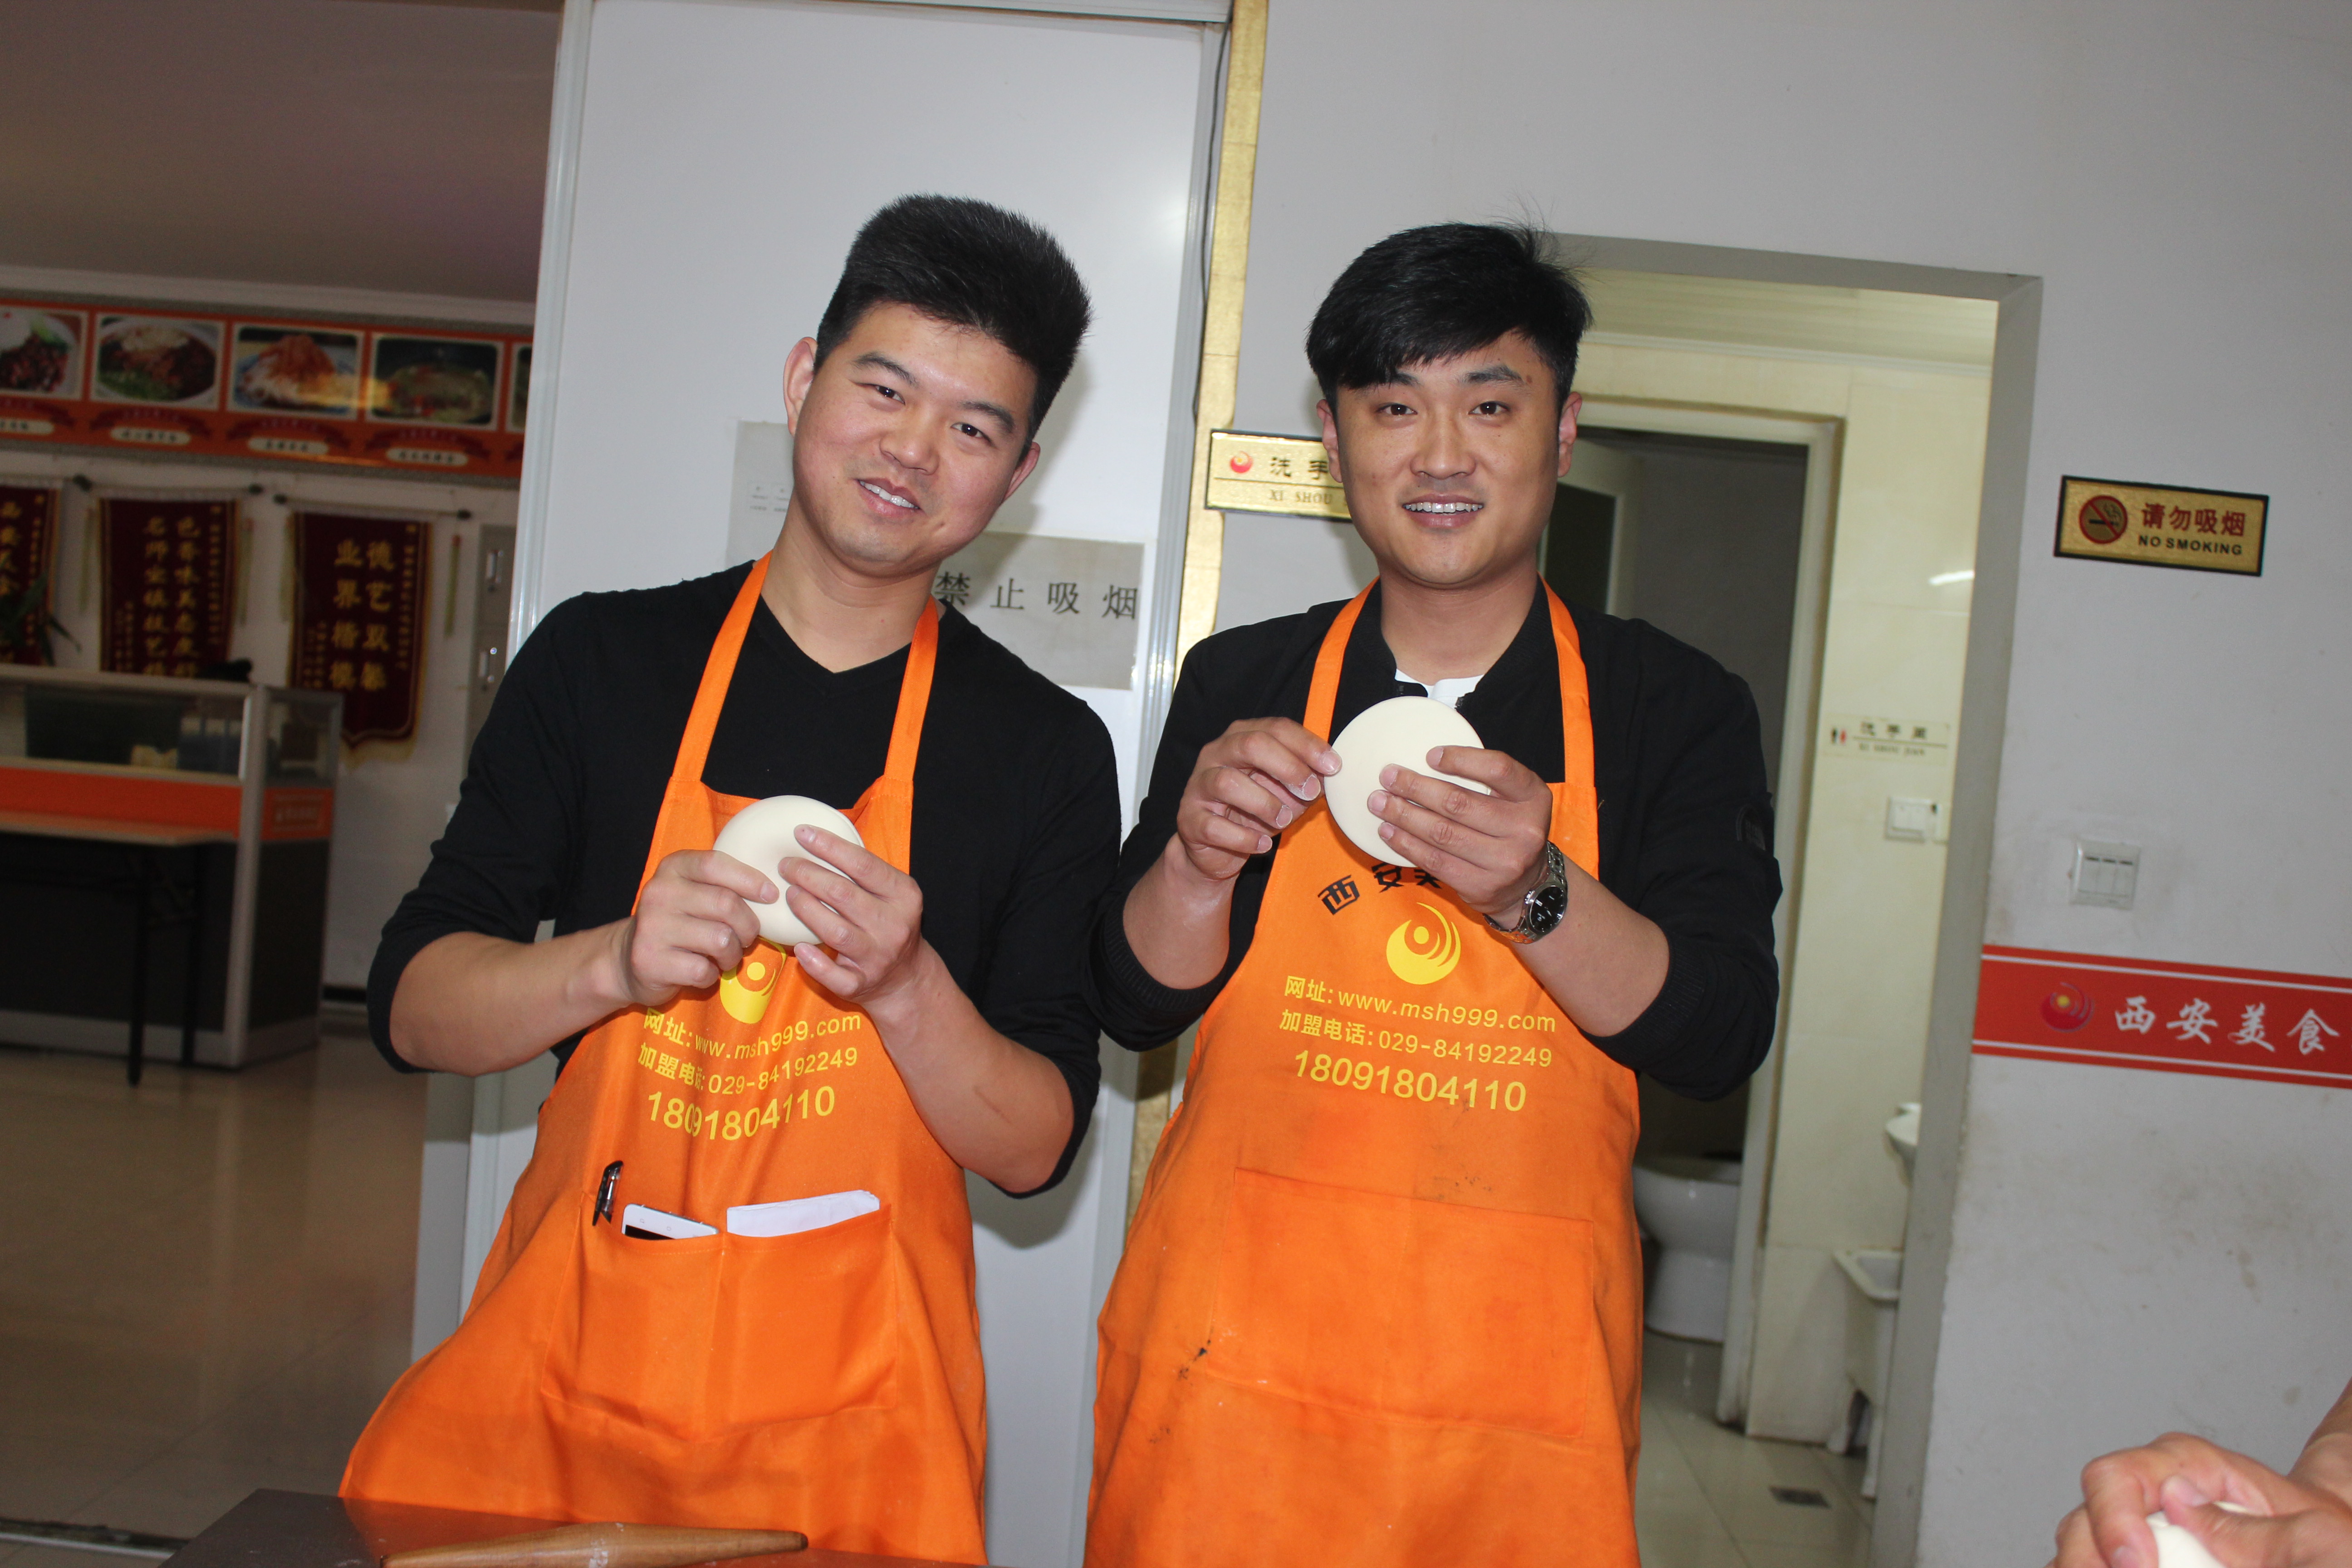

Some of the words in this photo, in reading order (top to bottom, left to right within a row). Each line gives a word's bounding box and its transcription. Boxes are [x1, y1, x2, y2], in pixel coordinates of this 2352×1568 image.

[1270, 489, 1284, 501] XI
[1295, 490, 1333, 505] SHOU
[2141, 502, 2246, 537] 请勿吸烟
[2139, 535, 2161, 546] NO
[2166, 537, 2242, 556] SMOKING
[934, 571, 1138, 620] 禁止吸烟
[2114, 996, 2339, 1055] 西安美食
[1294, 1050, 1527, 1112] 18091804110
[648, 1086, 835, 1141] 18091804110
